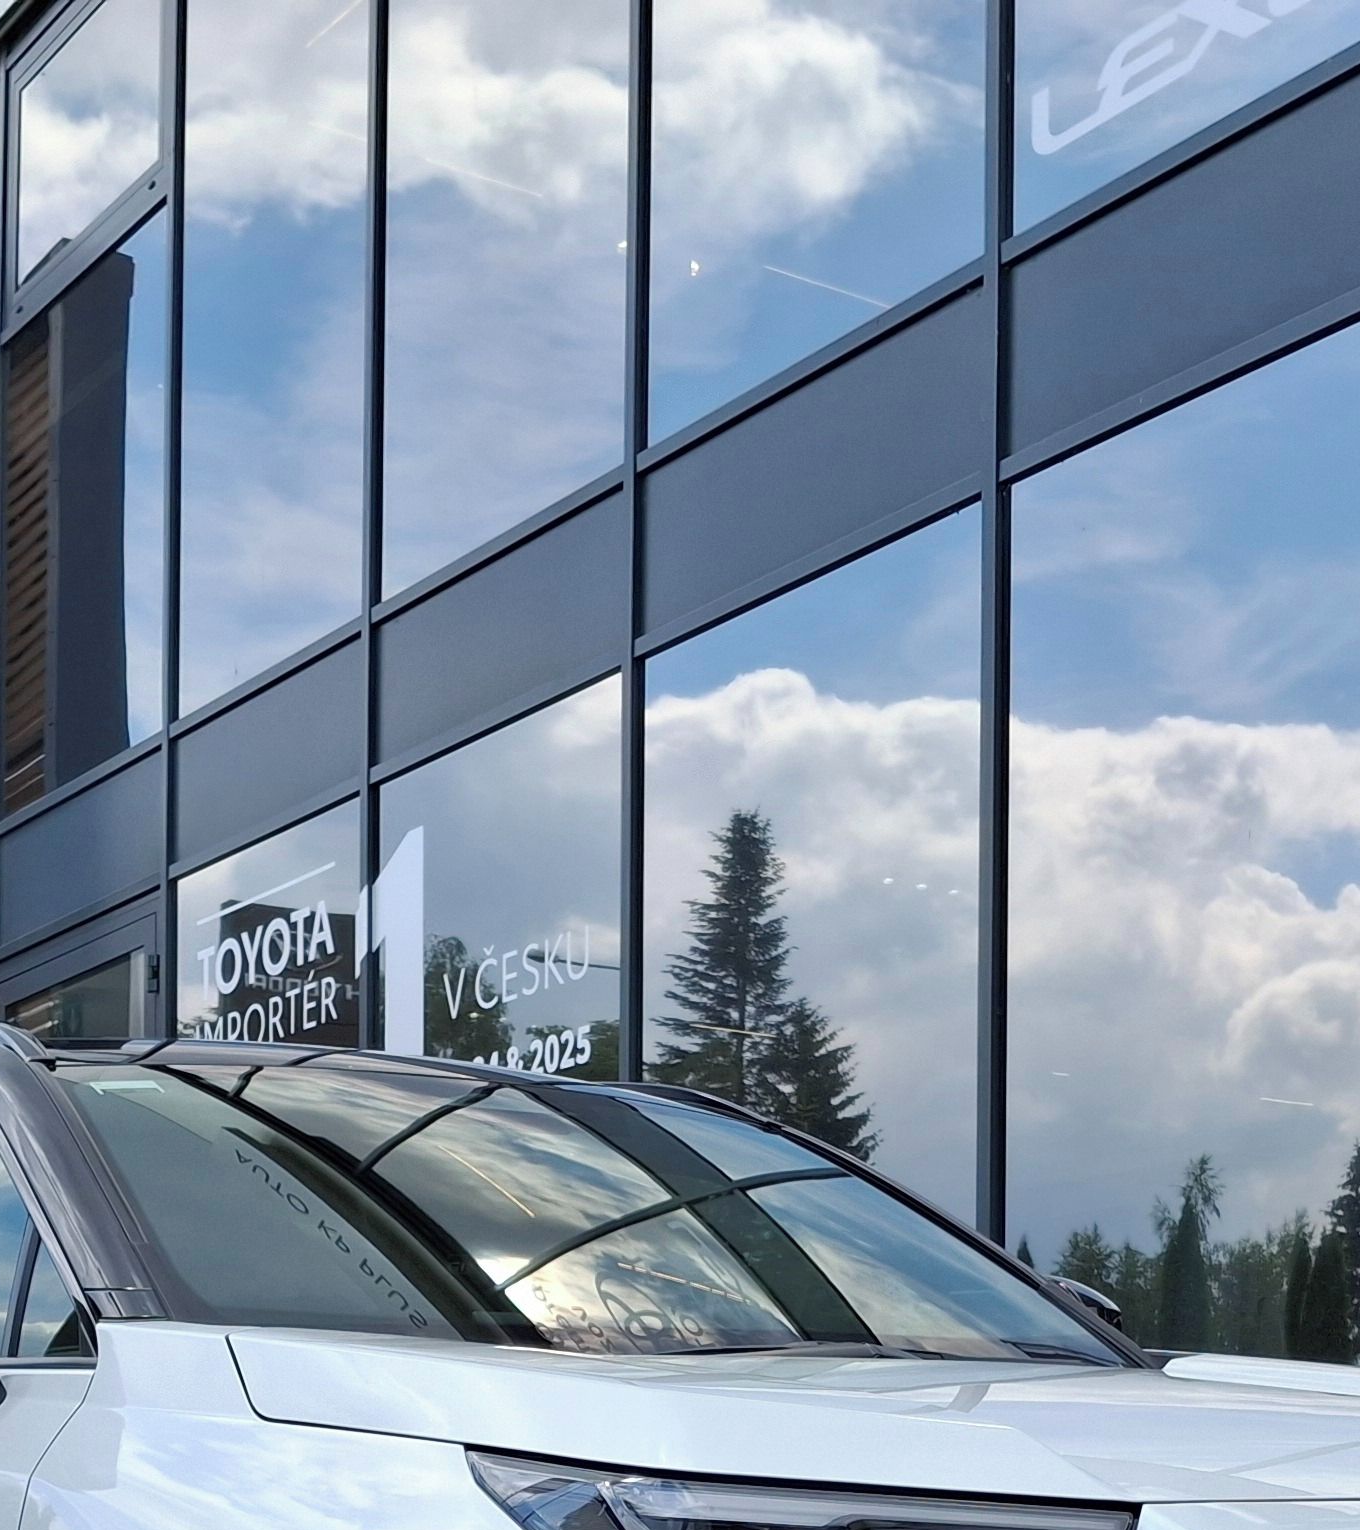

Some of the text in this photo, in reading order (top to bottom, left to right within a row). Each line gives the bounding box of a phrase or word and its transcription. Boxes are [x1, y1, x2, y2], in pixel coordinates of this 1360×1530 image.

[1031, 0, 1313, 155] LEX
[196, 900, 335, 1001] TOYOTA
[443, 924, 590, 1020] V ČESKU
[195, 969, 338, 1043] PORTÉR
[529, 1025, 592, 1074] 2025
